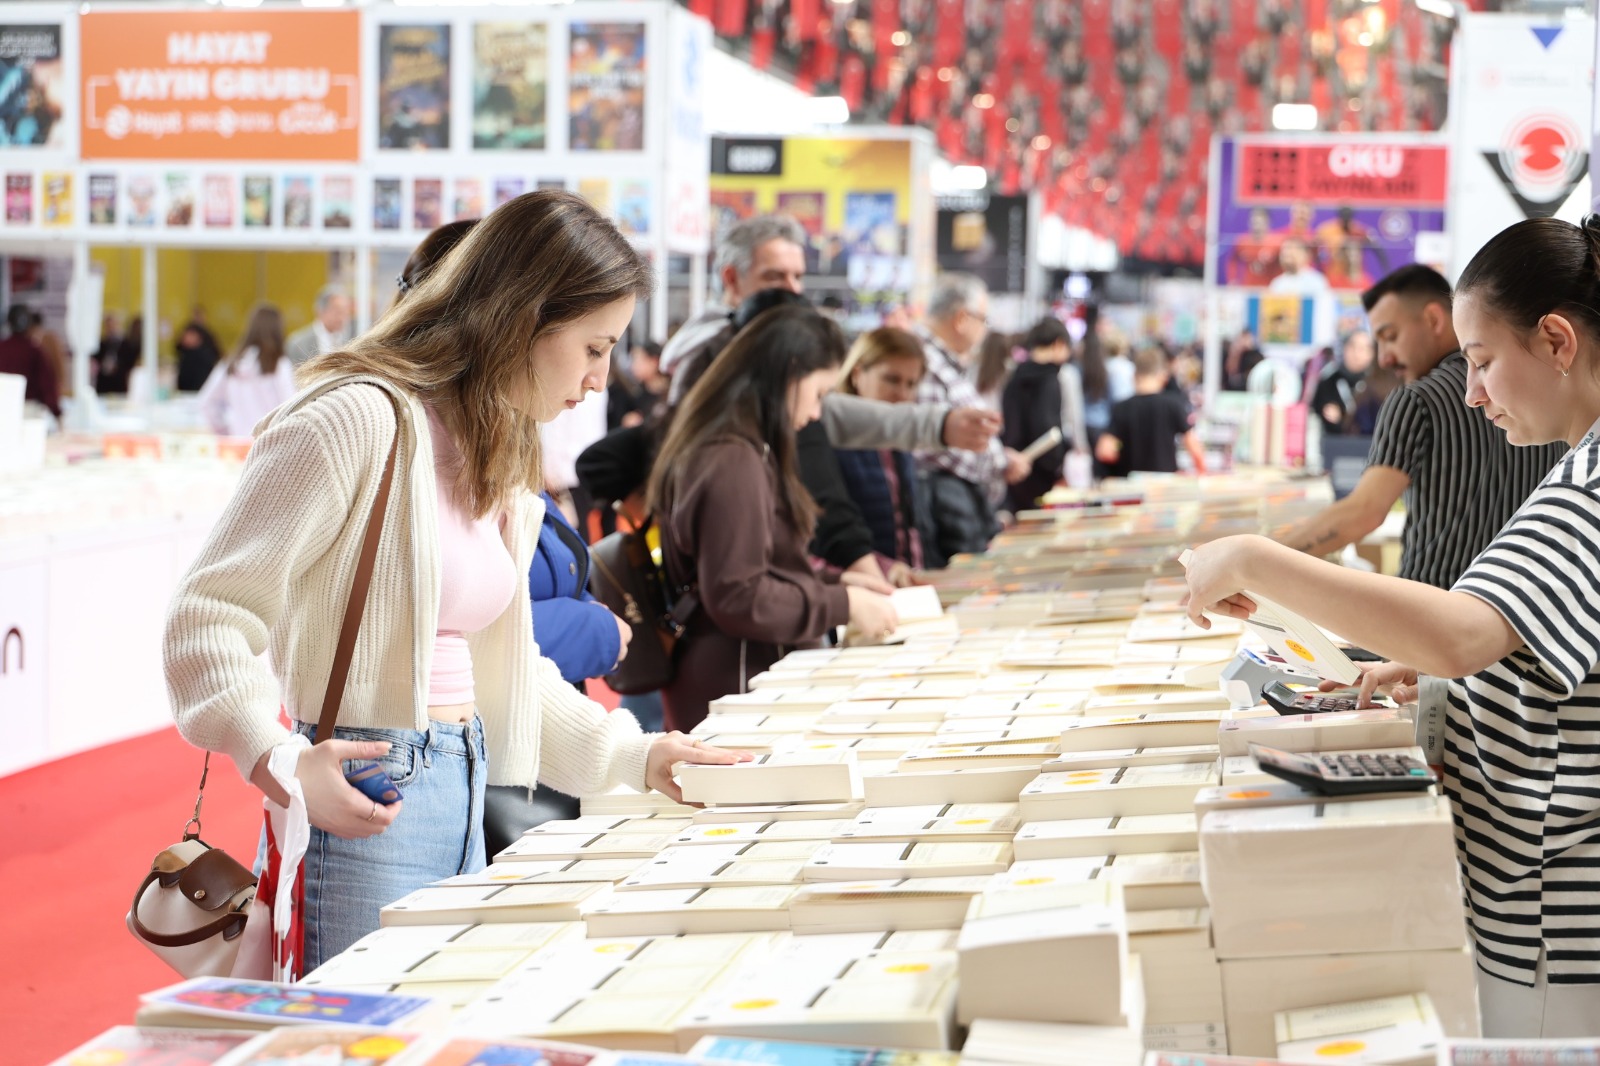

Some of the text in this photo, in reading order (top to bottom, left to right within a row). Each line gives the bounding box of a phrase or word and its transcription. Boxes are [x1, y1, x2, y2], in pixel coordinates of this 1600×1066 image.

[167, 32, 271, 63] HAYAT
[115, 68, 330, 99] YAYIN GRUBU
[1328, 143, 1404, 178] OKU
